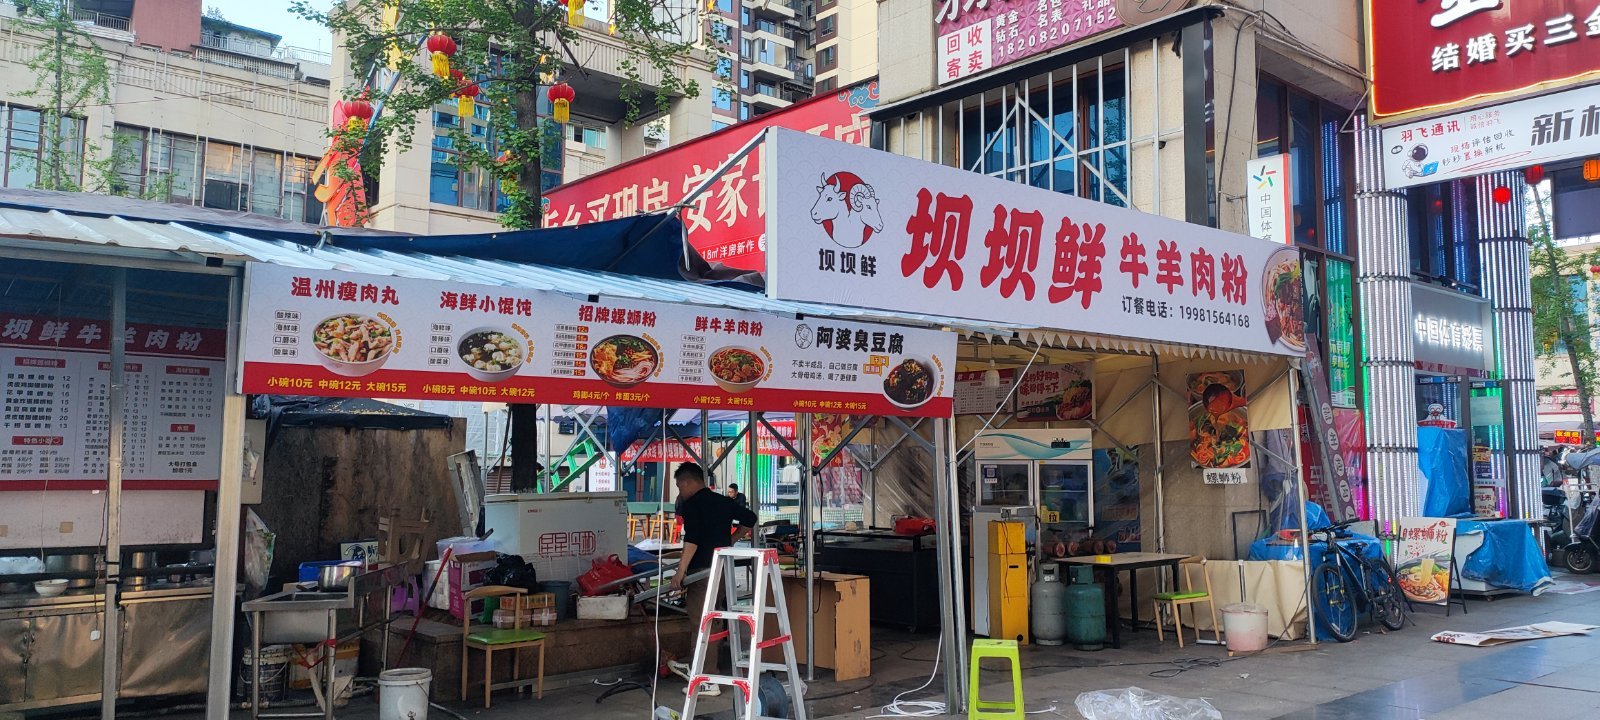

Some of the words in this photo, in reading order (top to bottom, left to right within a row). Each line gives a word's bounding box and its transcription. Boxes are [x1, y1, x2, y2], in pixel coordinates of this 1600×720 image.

[995, 10, 1019, 29] 黄金
[995, 25, 1020, 44] 钻石
[1037, 8, 1063, 28] 名表
[946, 25, 983, 55] 回收
[997, 7, 1117, 57] 18208207152
[946, 50, 983, 80] 寄卖
[1400, 120, 1460, 142] 羽飞通讯
[1451, 129, 1515, 153] 现场评估回收
[1442, 144, 1506, 167] 秒秒置换新机
[901, 187, 1106, 310] 坝坝鲜
[1119, 232, 1248, 306] 牛羊肉粉
[818, 248, 877, 278] 坝坝鲜
[290, 276, 400, 306] 温州瘦肉丸
[440, 290, 532, 317] 海鲜小馄饨
[276, 323, 298, 331] 海鲜味
[578, 304, 657, 328] 招牌螺蛳粉
[694, 316, 763, 337] 鲜牛羊肉粉
[816, 326, 904, 355] 阿婆臭豆腐
[1415, 313, 1484, 351] 中国体育彩票
[267, 376, 313, 389] 小碗10元
[318, 380, 361, 391] 中碗12元
[365, 382, 407, 392] 大碗15元
[422, 383, 455, 395] 小碗8元
[460, 385, 497, 396] 中碗10元
[500, 388, 535, 398] 大碗12元
[693, 395, 721, 404] 小碗12元
[727, 397, 754, 406] 大碗15元
[793, 400, 817, 408] 小碗10元
[844, 402, 867, 410] 大碗15元
[1206, 471, 1242, 484] 螺蛳粉
